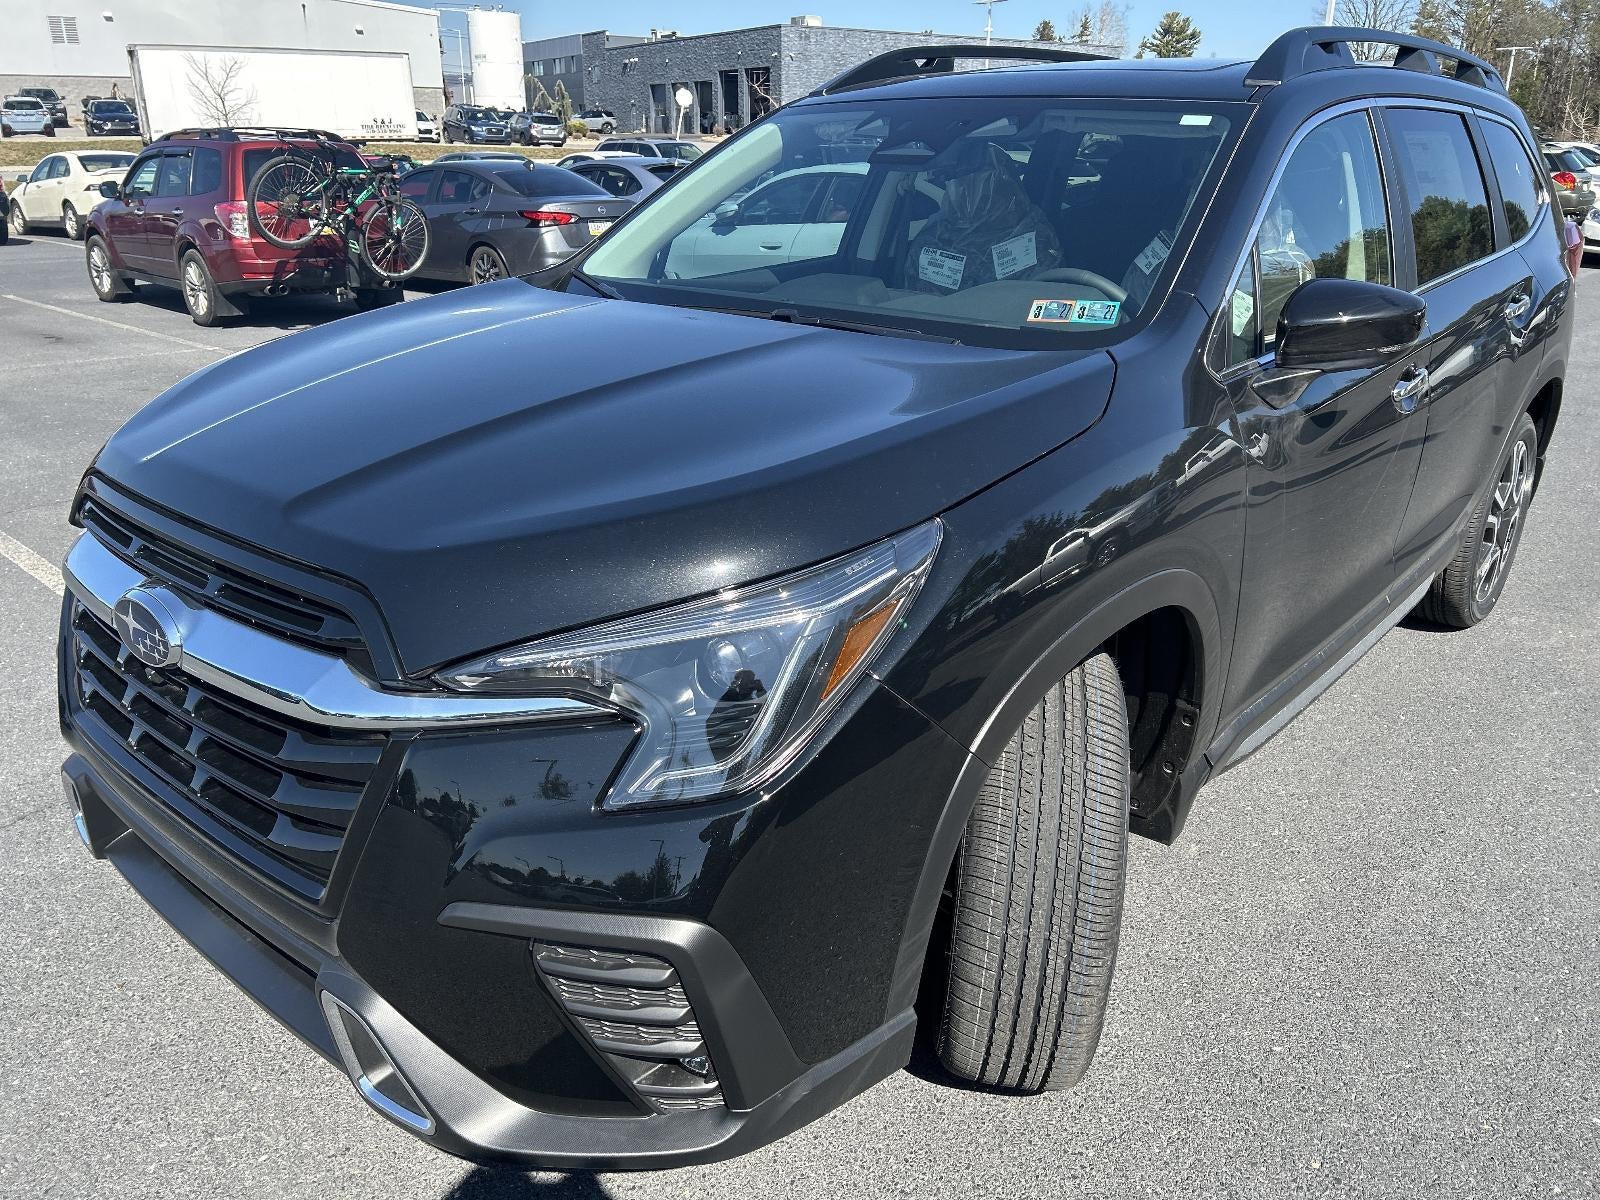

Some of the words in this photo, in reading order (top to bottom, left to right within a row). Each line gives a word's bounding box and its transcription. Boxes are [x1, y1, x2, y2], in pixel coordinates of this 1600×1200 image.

[373, 117, 378, 125] S
[1033, 305, 1043, 319] 3
[1058, 303, 1073, 319] 27
[1077, 305, 1087, 320] 3
[1103, 304, 1117, 320] 27
